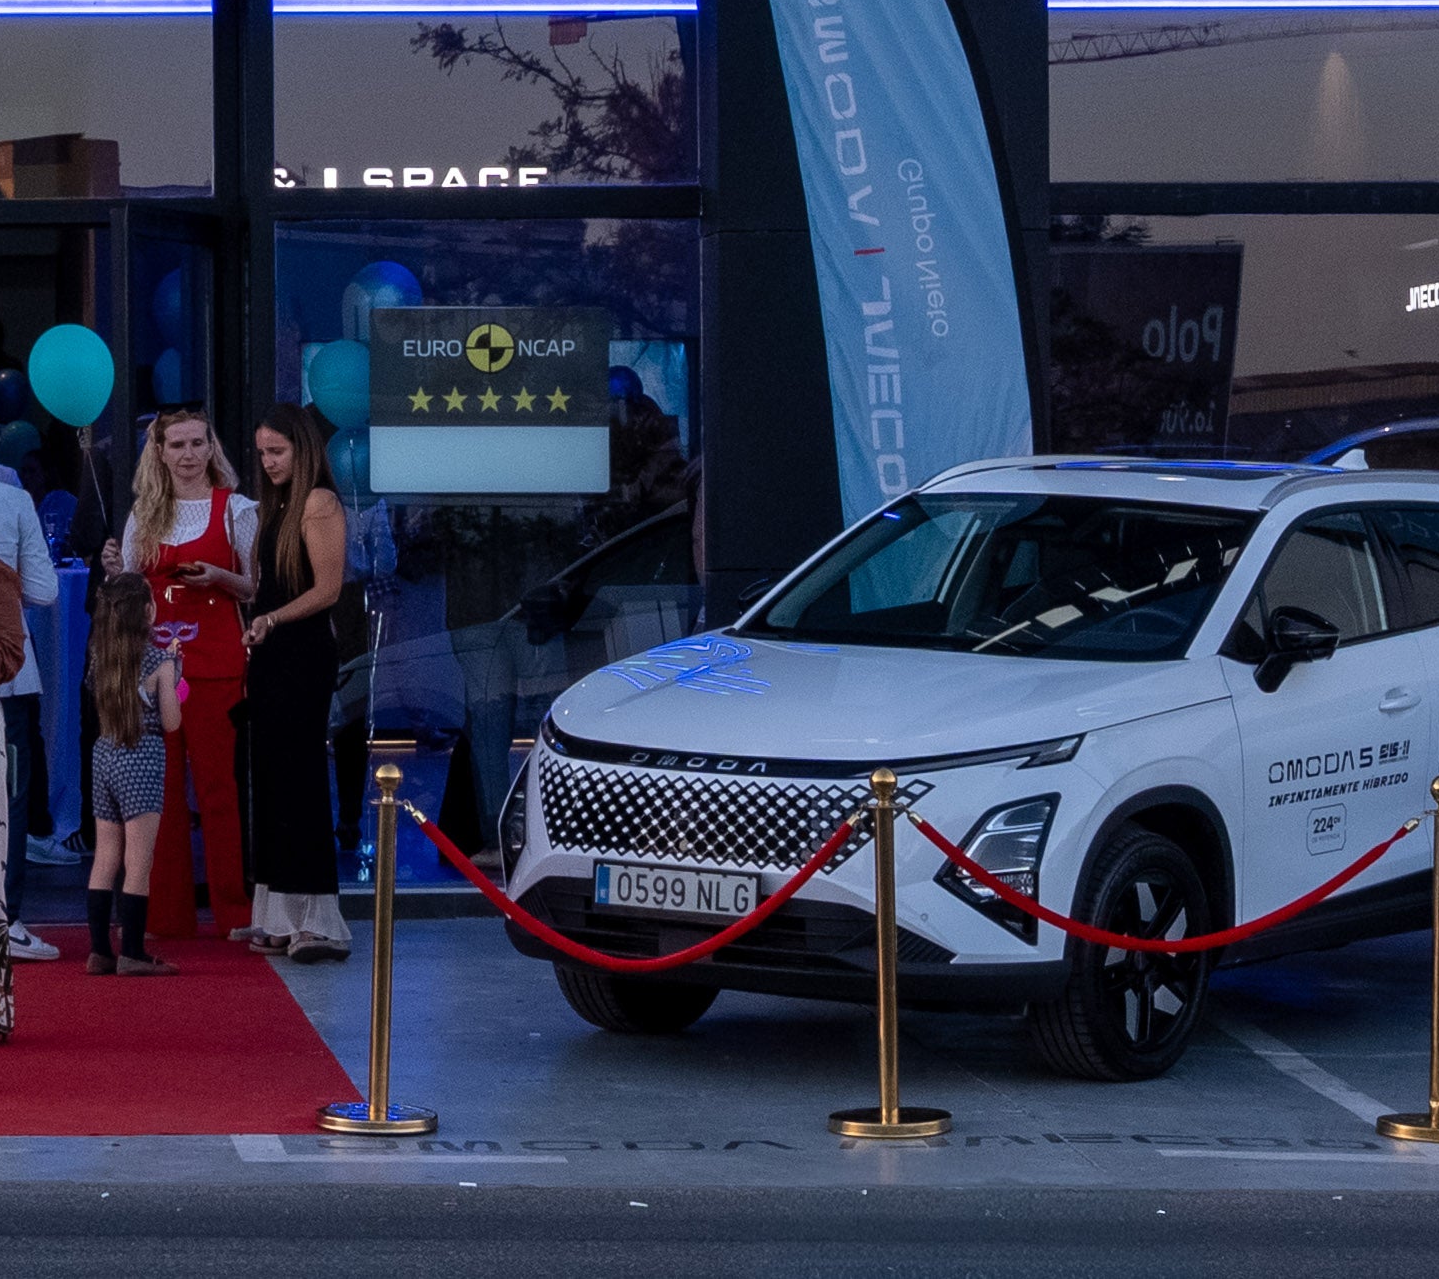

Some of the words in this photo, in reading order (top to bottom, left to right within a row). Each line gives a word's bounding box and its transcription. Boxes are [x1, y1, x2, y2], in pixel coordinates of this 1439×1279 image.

[402, 338, 462, 358] EURO
[518, 337, 576, 357] NCAP
[628, 751, 767, 774] OMODA
[1268, 749, 1355, 785] OMODA
[1359, 746, 1374, 769] 5
[1268, 780, 1361, 808] INFINITAMENTE
[616, 871, 688, 909] 0599
[695, 877, 751, 914] NLG
